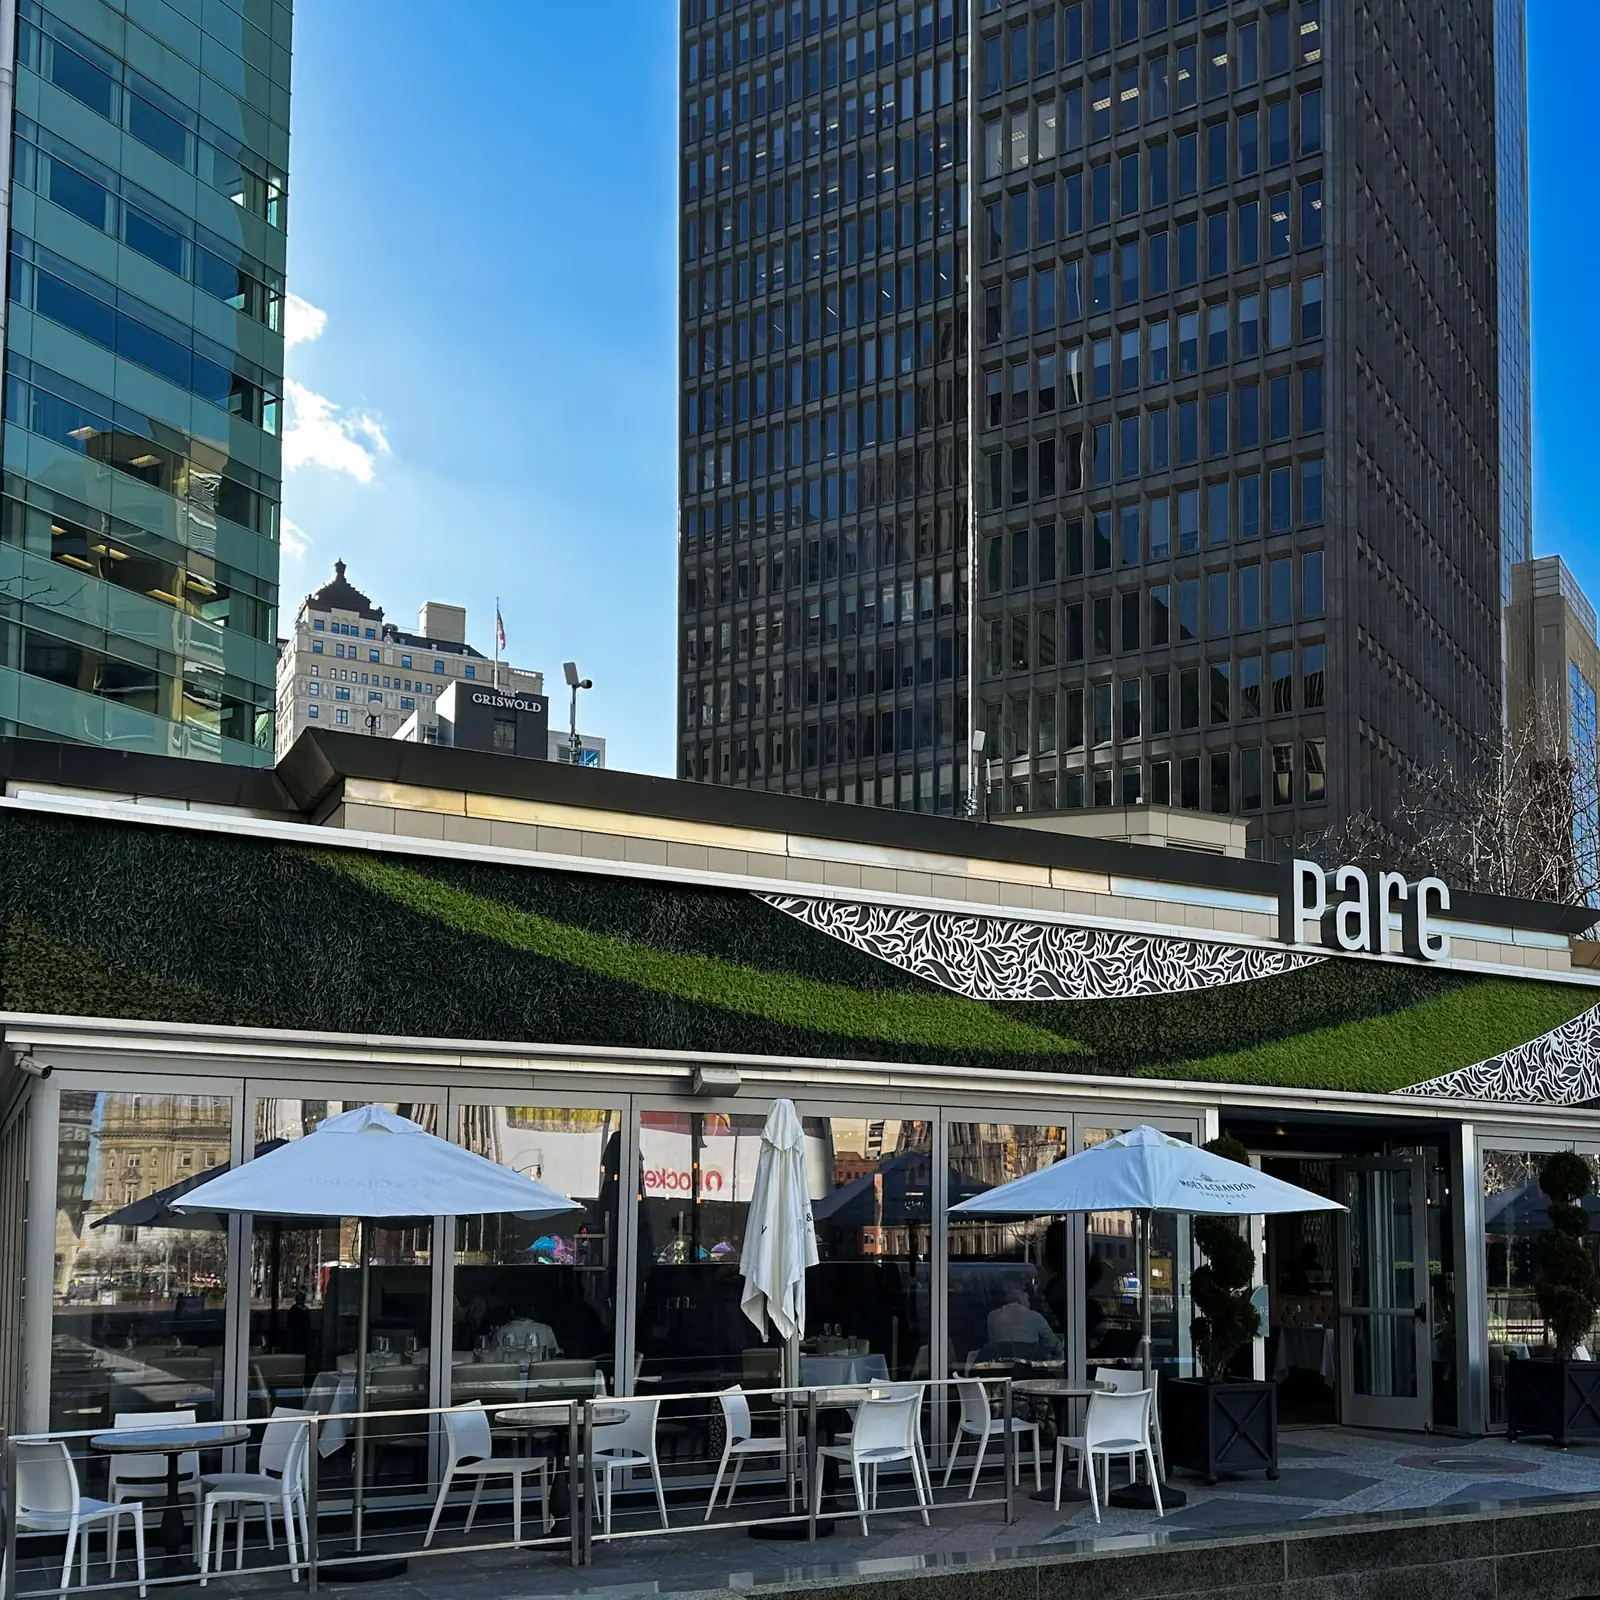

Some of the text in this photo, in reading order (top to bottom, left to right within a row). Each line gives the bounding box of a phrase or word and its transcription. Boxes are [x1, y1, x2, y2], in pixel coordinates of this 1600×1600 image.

[499, 689, 516, 698] THE
[472, 693, 541, 712] GRISWOLD
[805, 1212, 813, 1222] &
